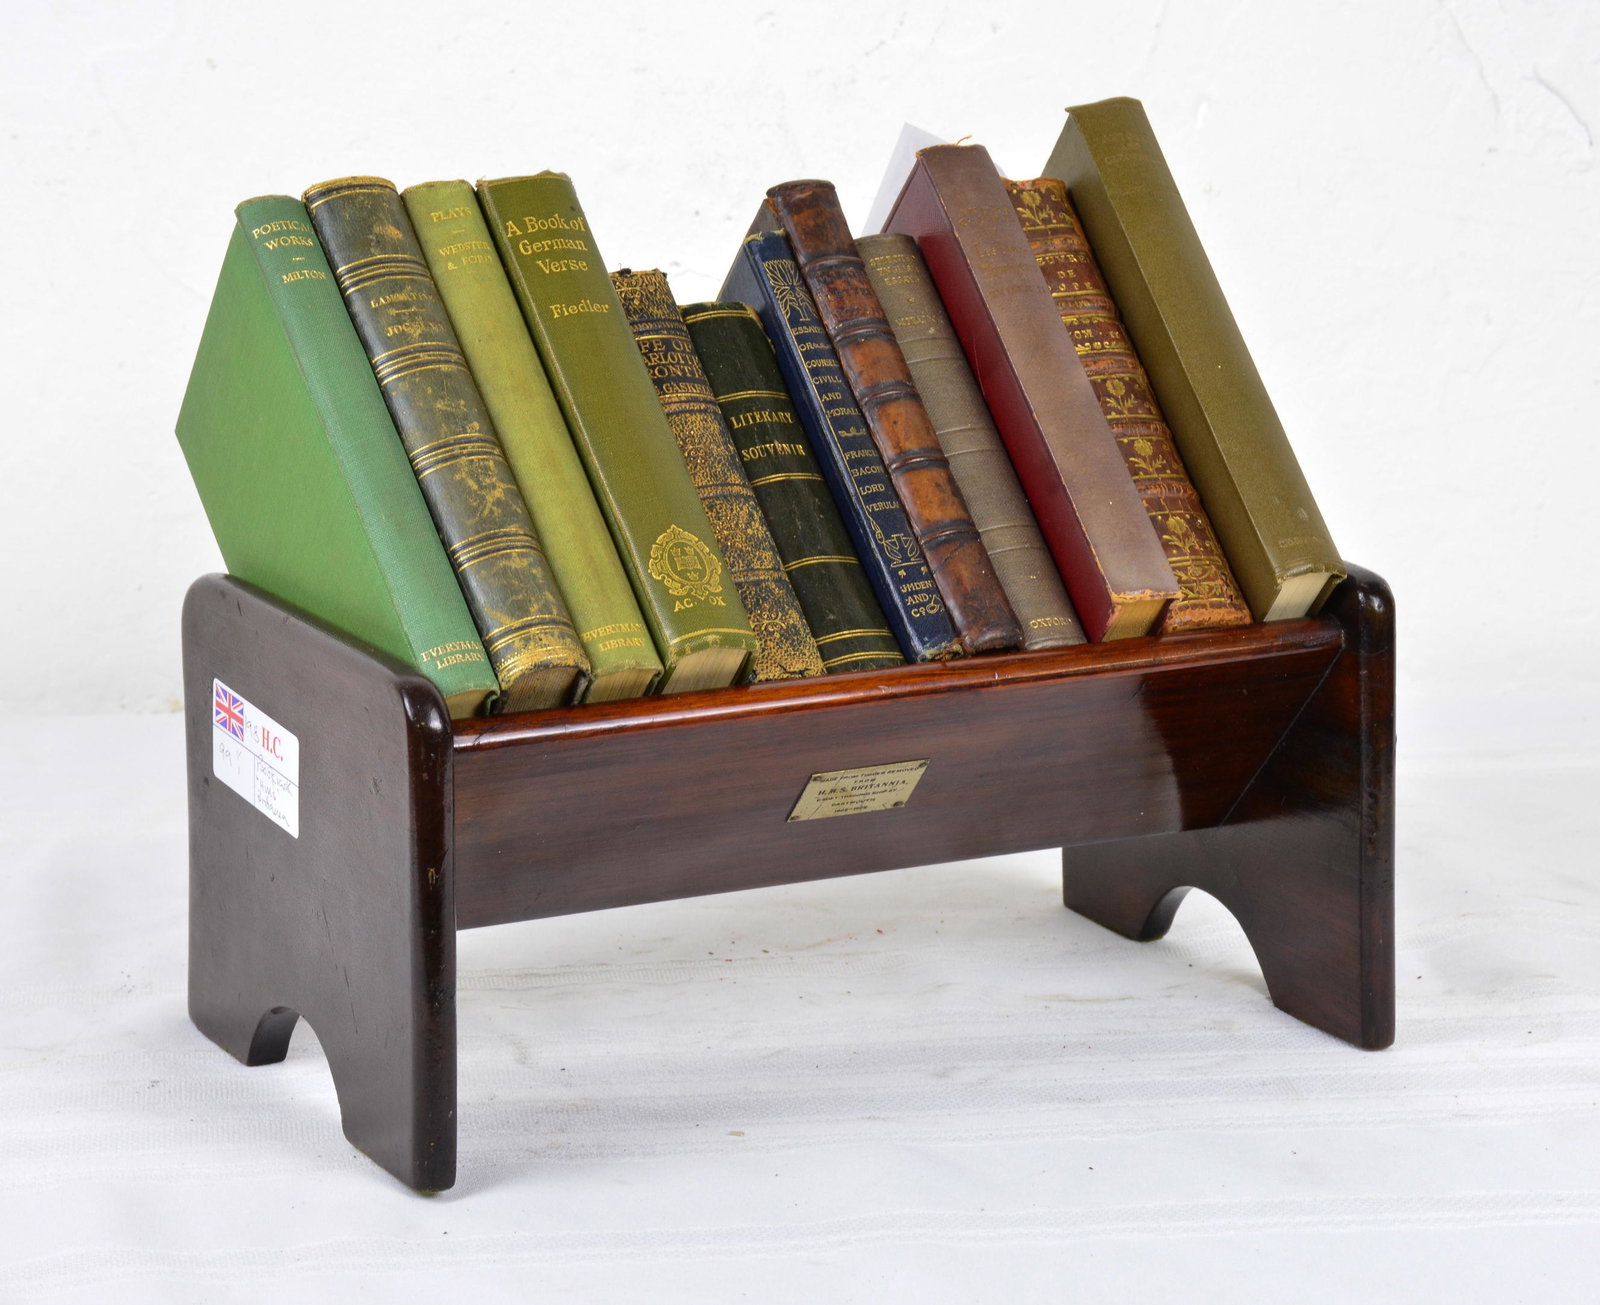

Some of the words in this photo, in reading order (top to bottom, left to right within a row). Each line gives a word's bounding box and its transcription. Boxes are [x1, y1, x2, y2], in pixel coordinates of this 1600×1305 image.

[431, 207, 472, 222] PLAYS
[507, 220, 522, 238] A
[524, 213, 569, 233] Book
[570, 216, 586, 232] of
[264, 236, 314, 250] WORKS
[439, 241, 490, 256] WEBSTER
[519, 238, 588, 255] German
[447, 262, 458, 270] &
[536, 258, 588, 275] Verse
[281, 270, 327, 284] MILTON
[1057, 269, 1077, 279] DE
[550, 300, 609, 319] Fiedler
[821, 391, 842, 402] AND
[730, 411, 794, 429] LITERARY
[741, 443, 806, 461] SOUVENIR
[850, 465, 884, 477] BACON
[859, 483, 886, 496] LORD
[599, 637, 646, 652] LIBRARY
